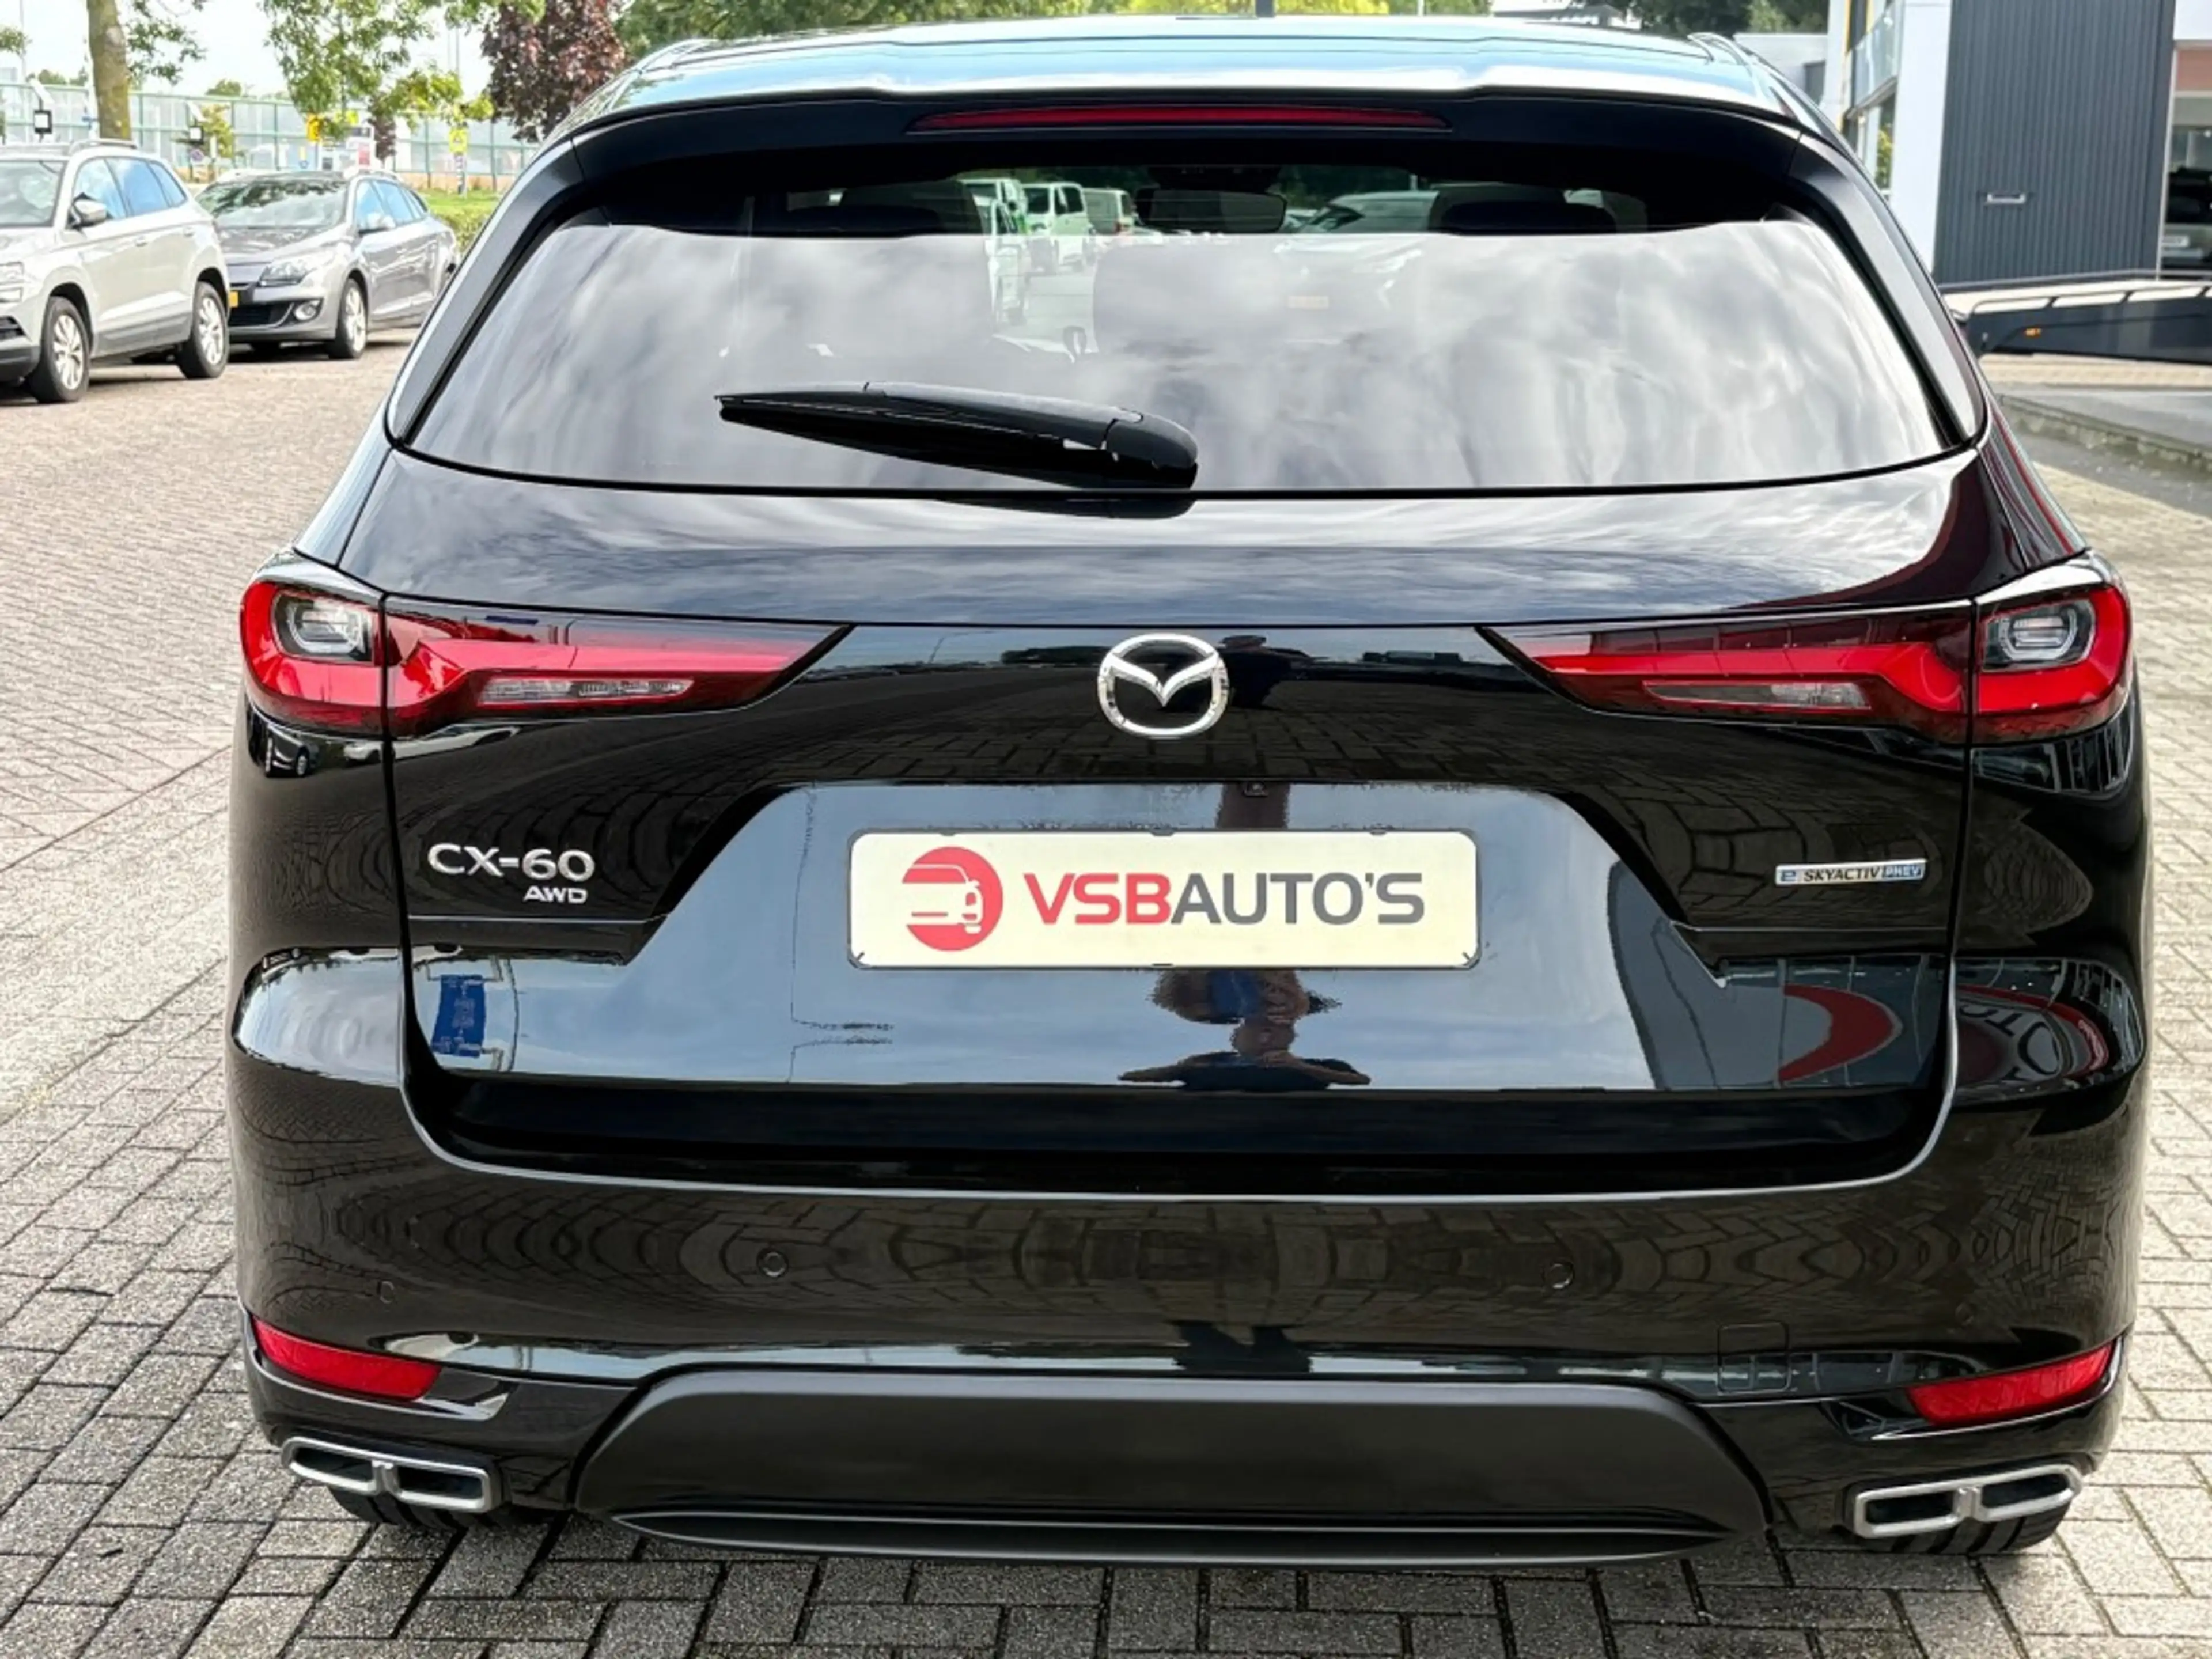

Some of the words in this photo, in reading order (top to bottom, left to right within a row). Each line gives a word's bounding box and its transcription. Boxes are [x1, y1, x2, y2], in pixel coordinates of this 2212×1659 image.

[427, 842, 596, 882] CX-60
[1804, 868, 1880, 882] SKYACTIV
[522, 885, 588, 904] AWD
